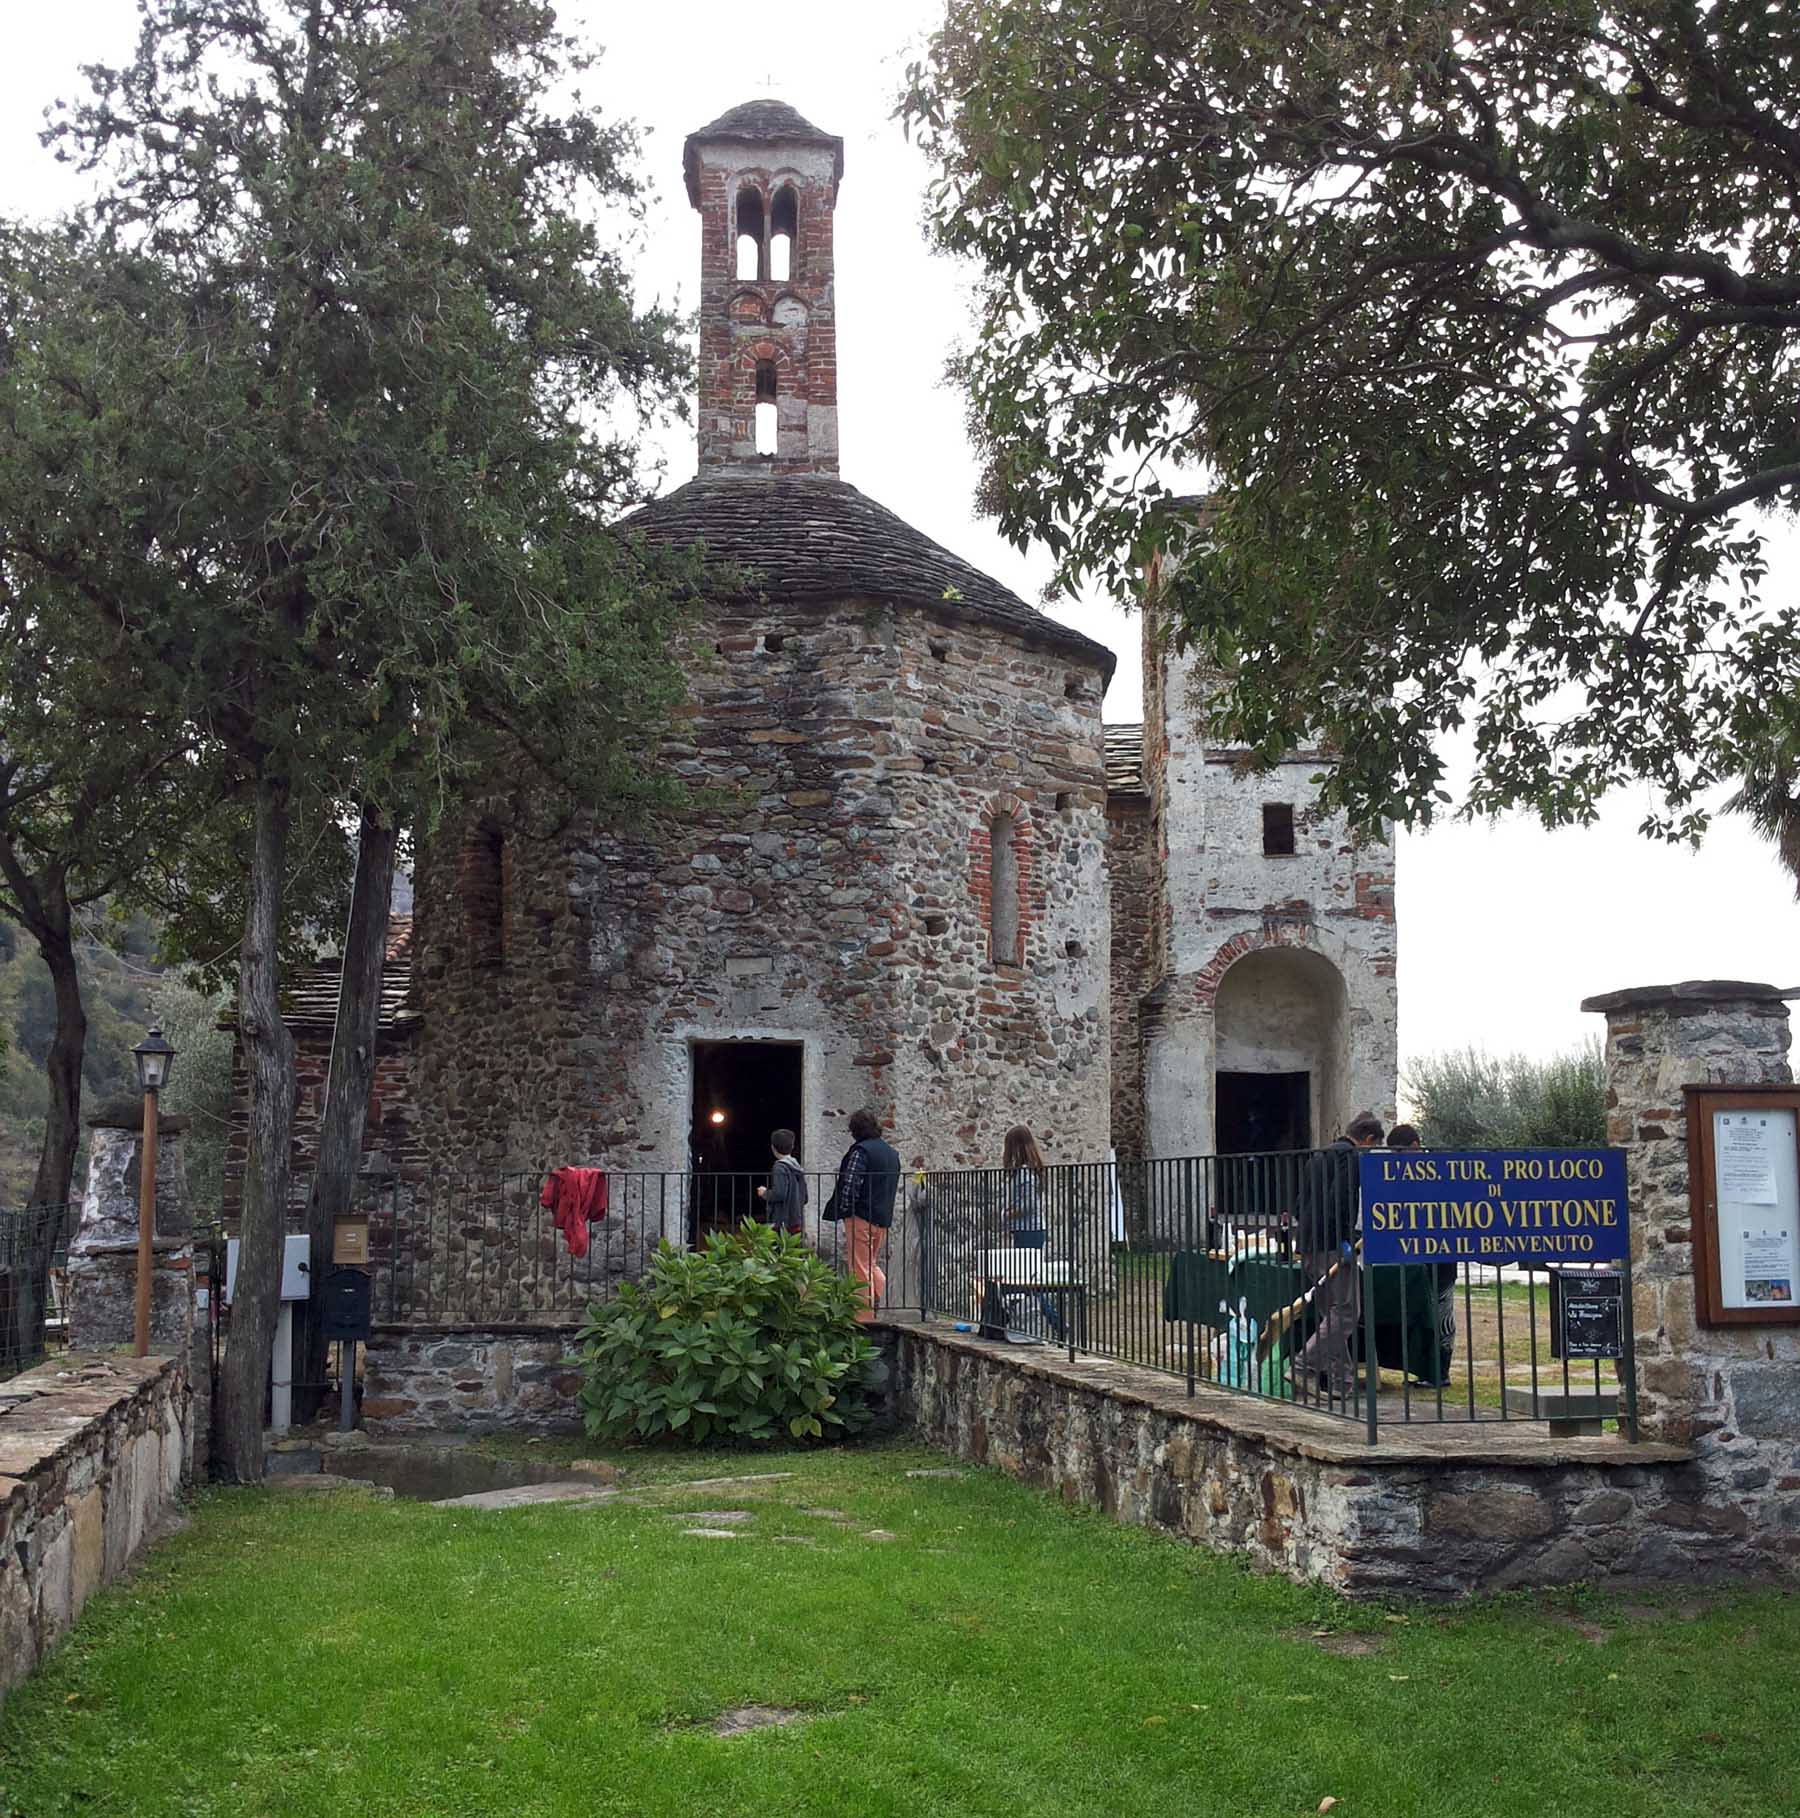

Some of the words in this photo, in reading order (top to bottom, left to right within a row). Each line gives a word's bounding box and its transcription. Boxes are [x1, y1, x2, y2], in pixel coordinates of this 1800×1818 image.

[1383, 1160, 1441, 1181] L'ASS.
[1446, 1160, 1492, 1180] TUR.
[1503, 1159, 1543, 1180] PRO
[1548, 1158, 1604, 1180] LOCO
[1488, 1183, 1501, 1197] DI
[1371, 1200, 1494, 1231] SETTIMO
[1500, 1199, 1618, 1228] VITTONE
[1399, 1237, 1419, 1255] VI
[1424, 1237, 1451, 1254] DA
[1456, 1237, 1475, 1253] IL
[1480, 1234, 1593, 1254] BENVENUTO
